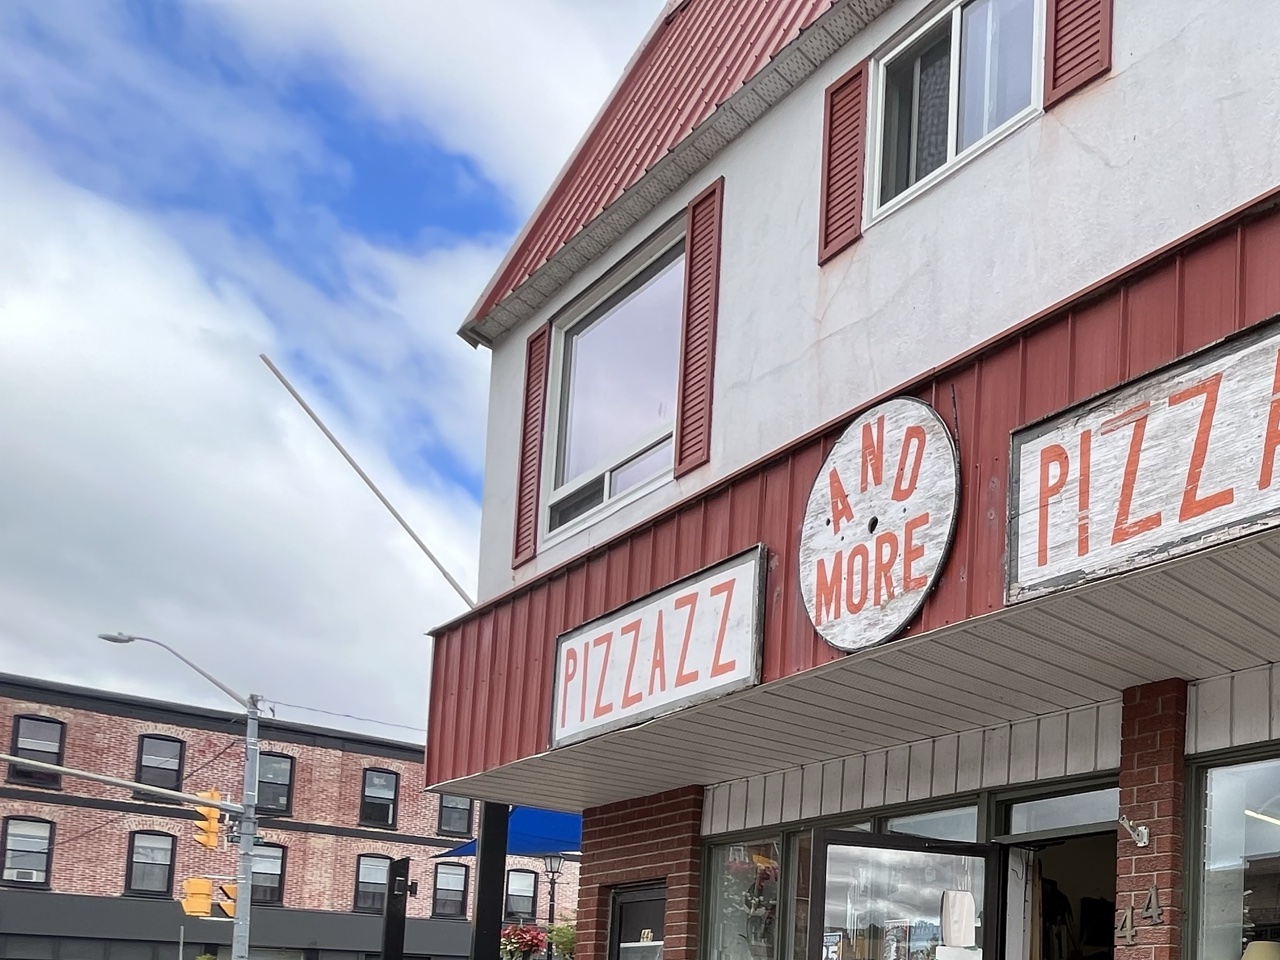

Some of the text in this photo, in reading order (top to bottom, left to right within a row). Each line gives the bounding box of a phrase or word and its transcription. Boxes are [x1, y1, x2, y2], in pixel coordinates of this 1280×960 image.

[828, 414, 927, 536] AND
[814, 512, 931, 627] MORE
[560, 578, 738, 730] PIZZAZZ
[1115, 884, 1165, 946] 44
